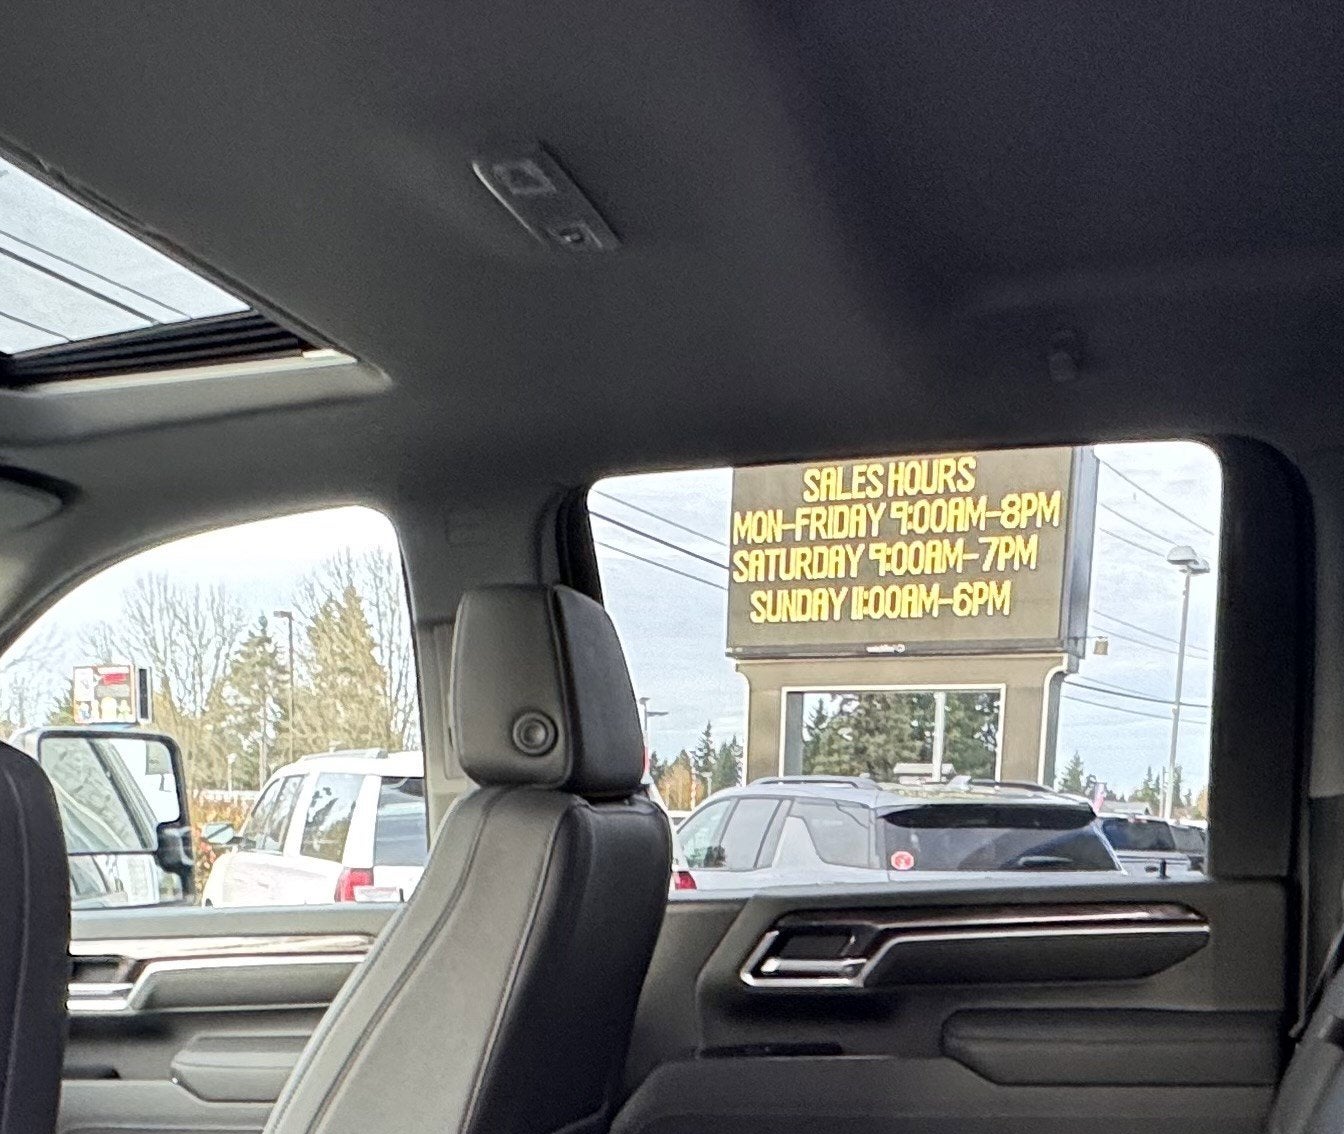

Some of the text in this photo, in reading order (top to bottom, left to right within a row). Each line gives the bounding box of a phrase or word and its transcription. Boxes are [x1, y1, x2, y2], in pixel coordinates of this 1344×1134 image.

[802, 456, 977, 502] SALES HOURS
[732, 490, 1062, 545] MON-FRIDAY 9:00AM-8PM
[732, 533, 1039, 583] SATURDAY 9:00AM-7PM
[749, 579, 1012, 624] SUNDAY 11:00AM-6PM
